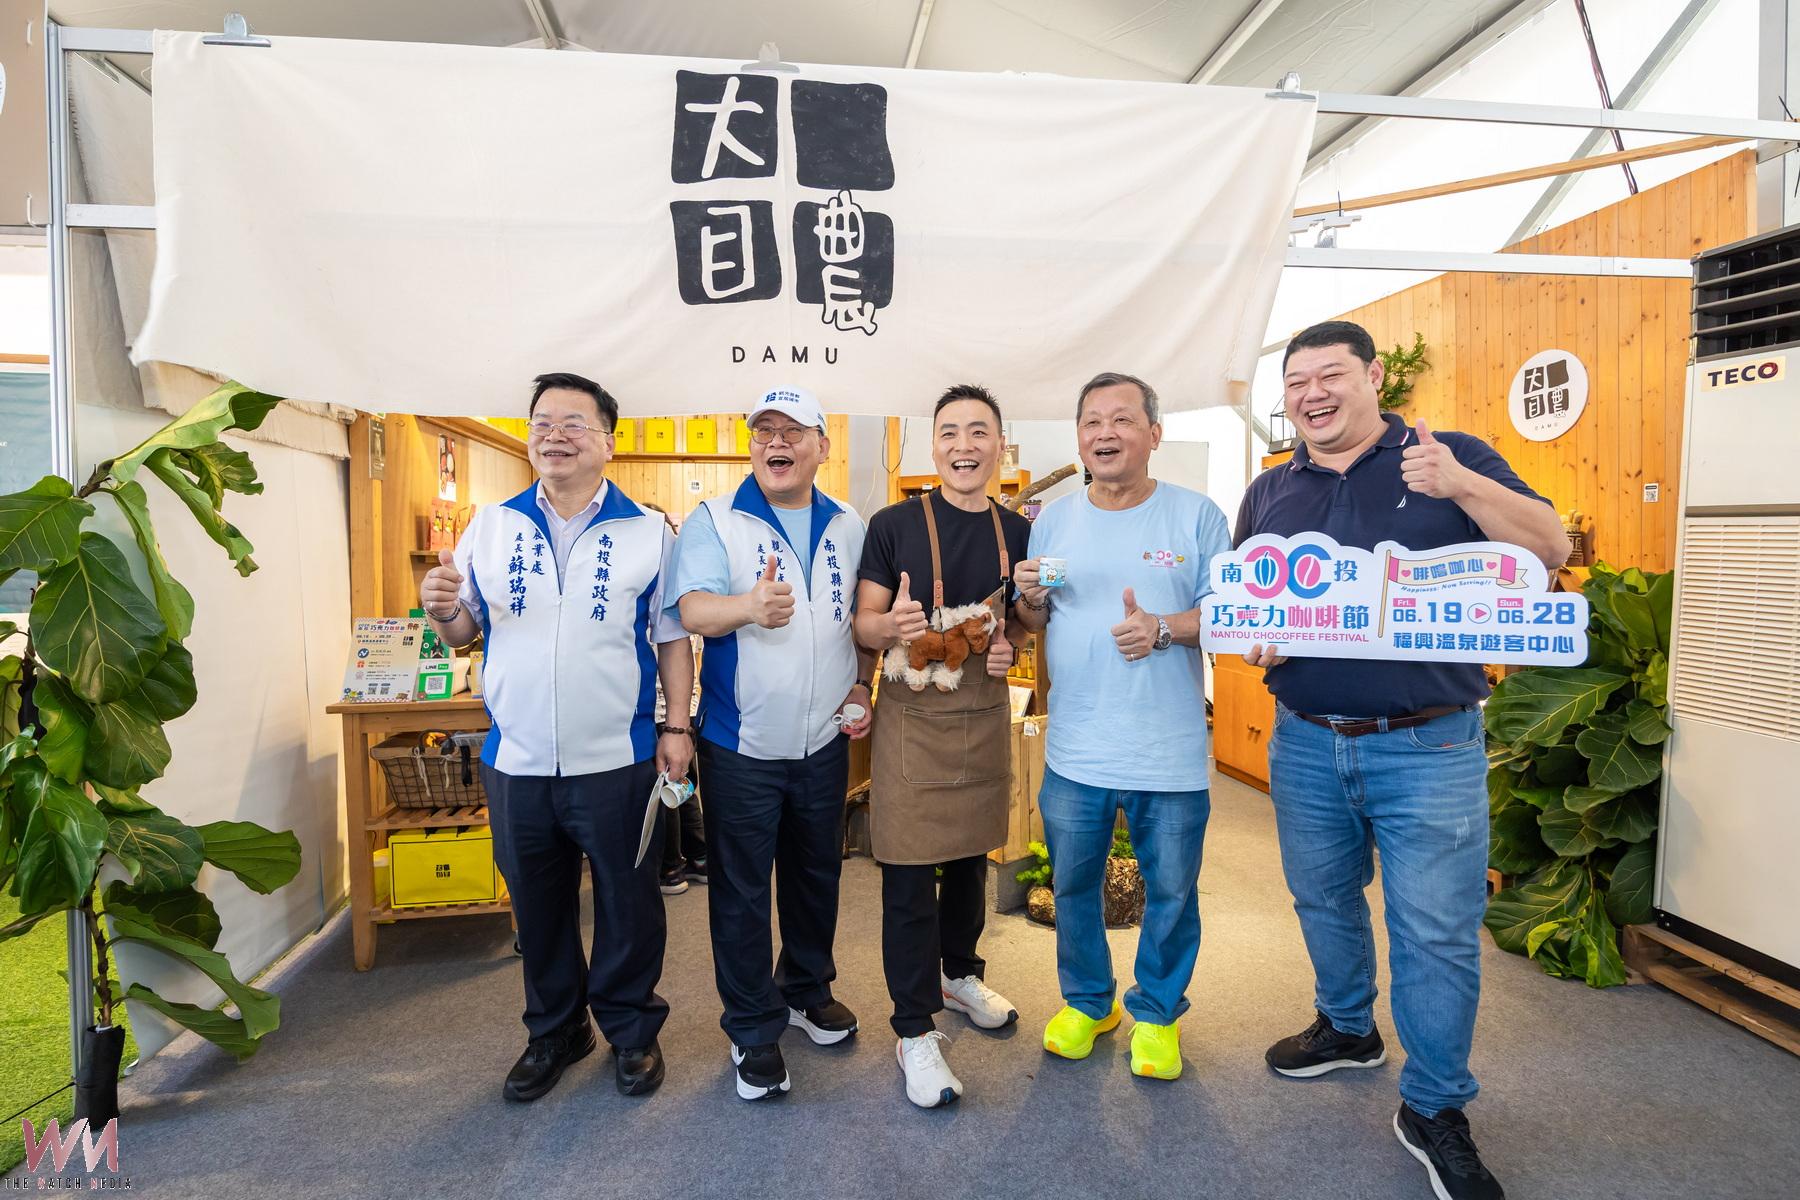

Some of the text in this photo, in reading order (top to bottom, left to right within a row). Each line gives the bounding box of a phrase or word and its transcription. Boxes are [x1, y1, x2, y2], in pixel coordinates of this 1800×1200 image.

[732, 345, 838, 365] DAMU
[1707, 361, 1779, 387] TECO
[590, 533, 613, 622] 南投縣政府
[824, 538, 844, 622] 南投縣政府
[1211, 604, 1369, 629] 巧克力咖啡節
[1210, 630, 1369, 643] NANTOU CHOCOFFEE FESTIVAL
[1393, 632, 1575, 654] 福興溫泉遊客中心
